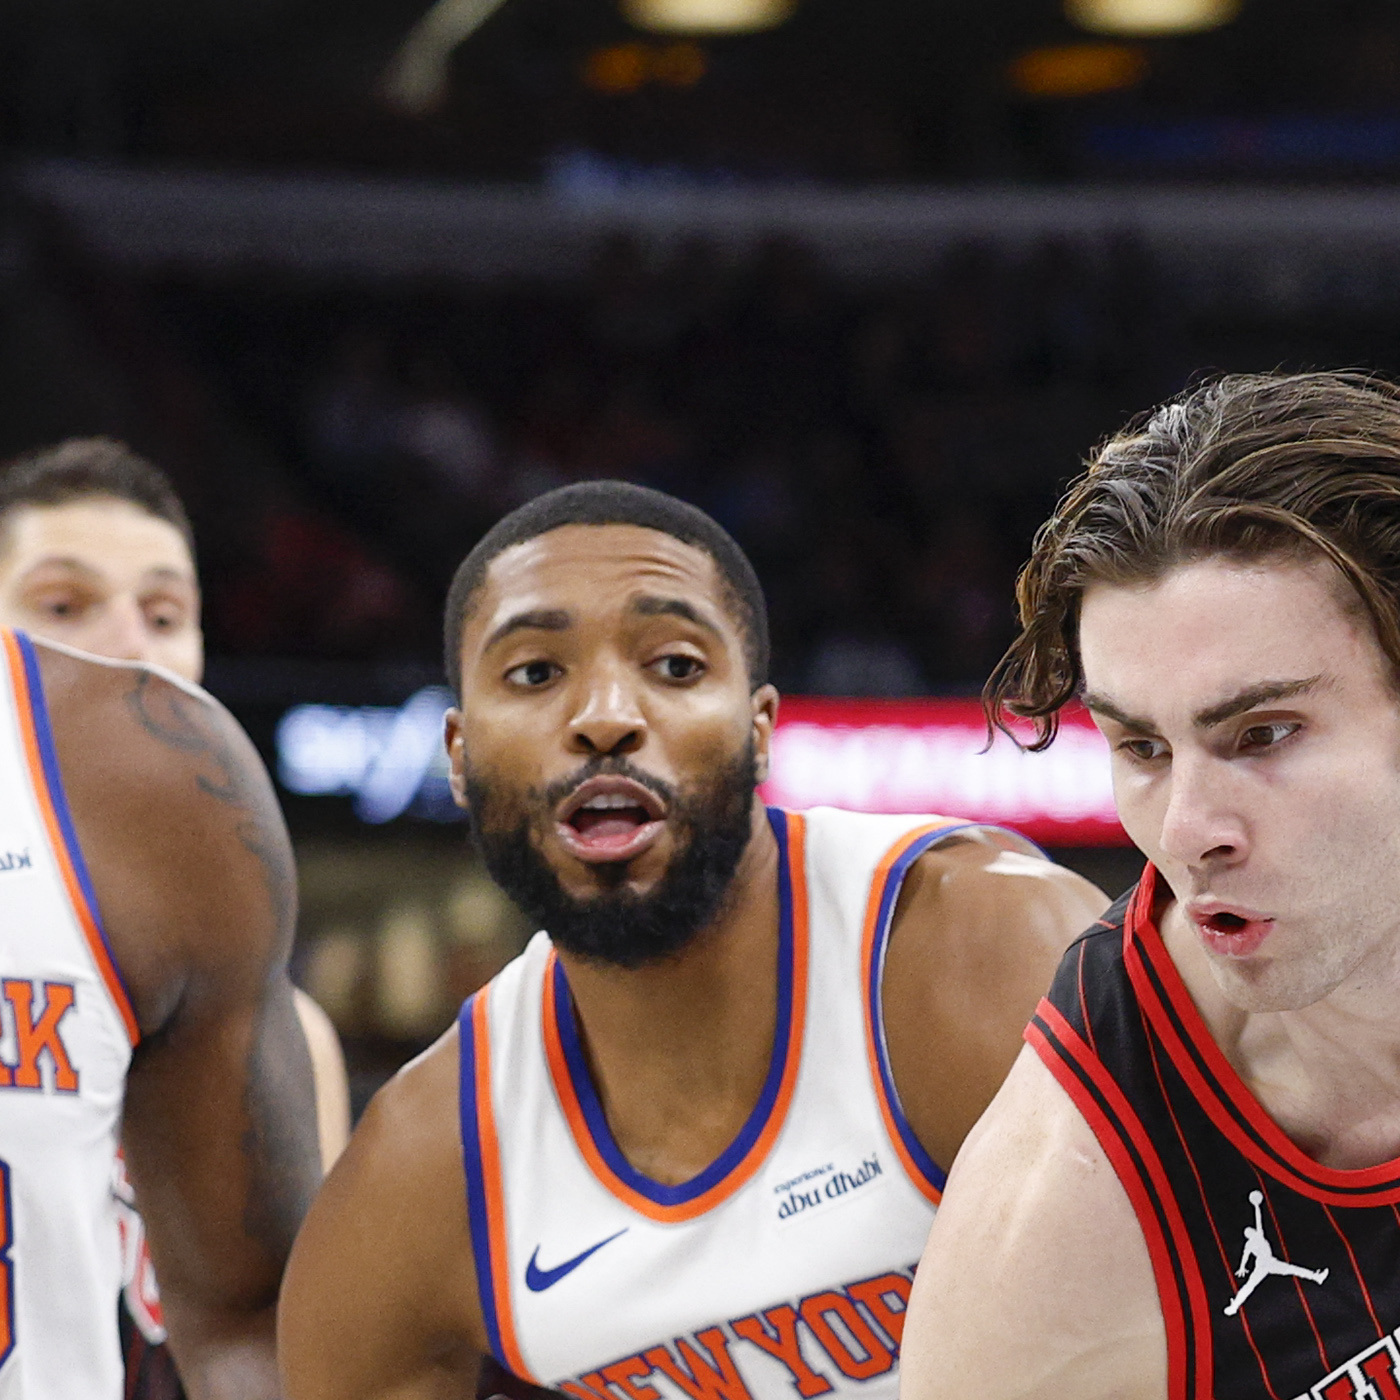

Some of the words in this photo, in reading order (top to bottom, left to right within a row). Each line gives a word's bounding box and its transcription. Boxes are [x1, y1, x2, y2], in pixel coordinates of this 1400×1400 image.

[778, 1188, 822, 1219] abu
[825, 1151, 883, 1198] dhabi
[729, 1262, 920, 1400] YOR
